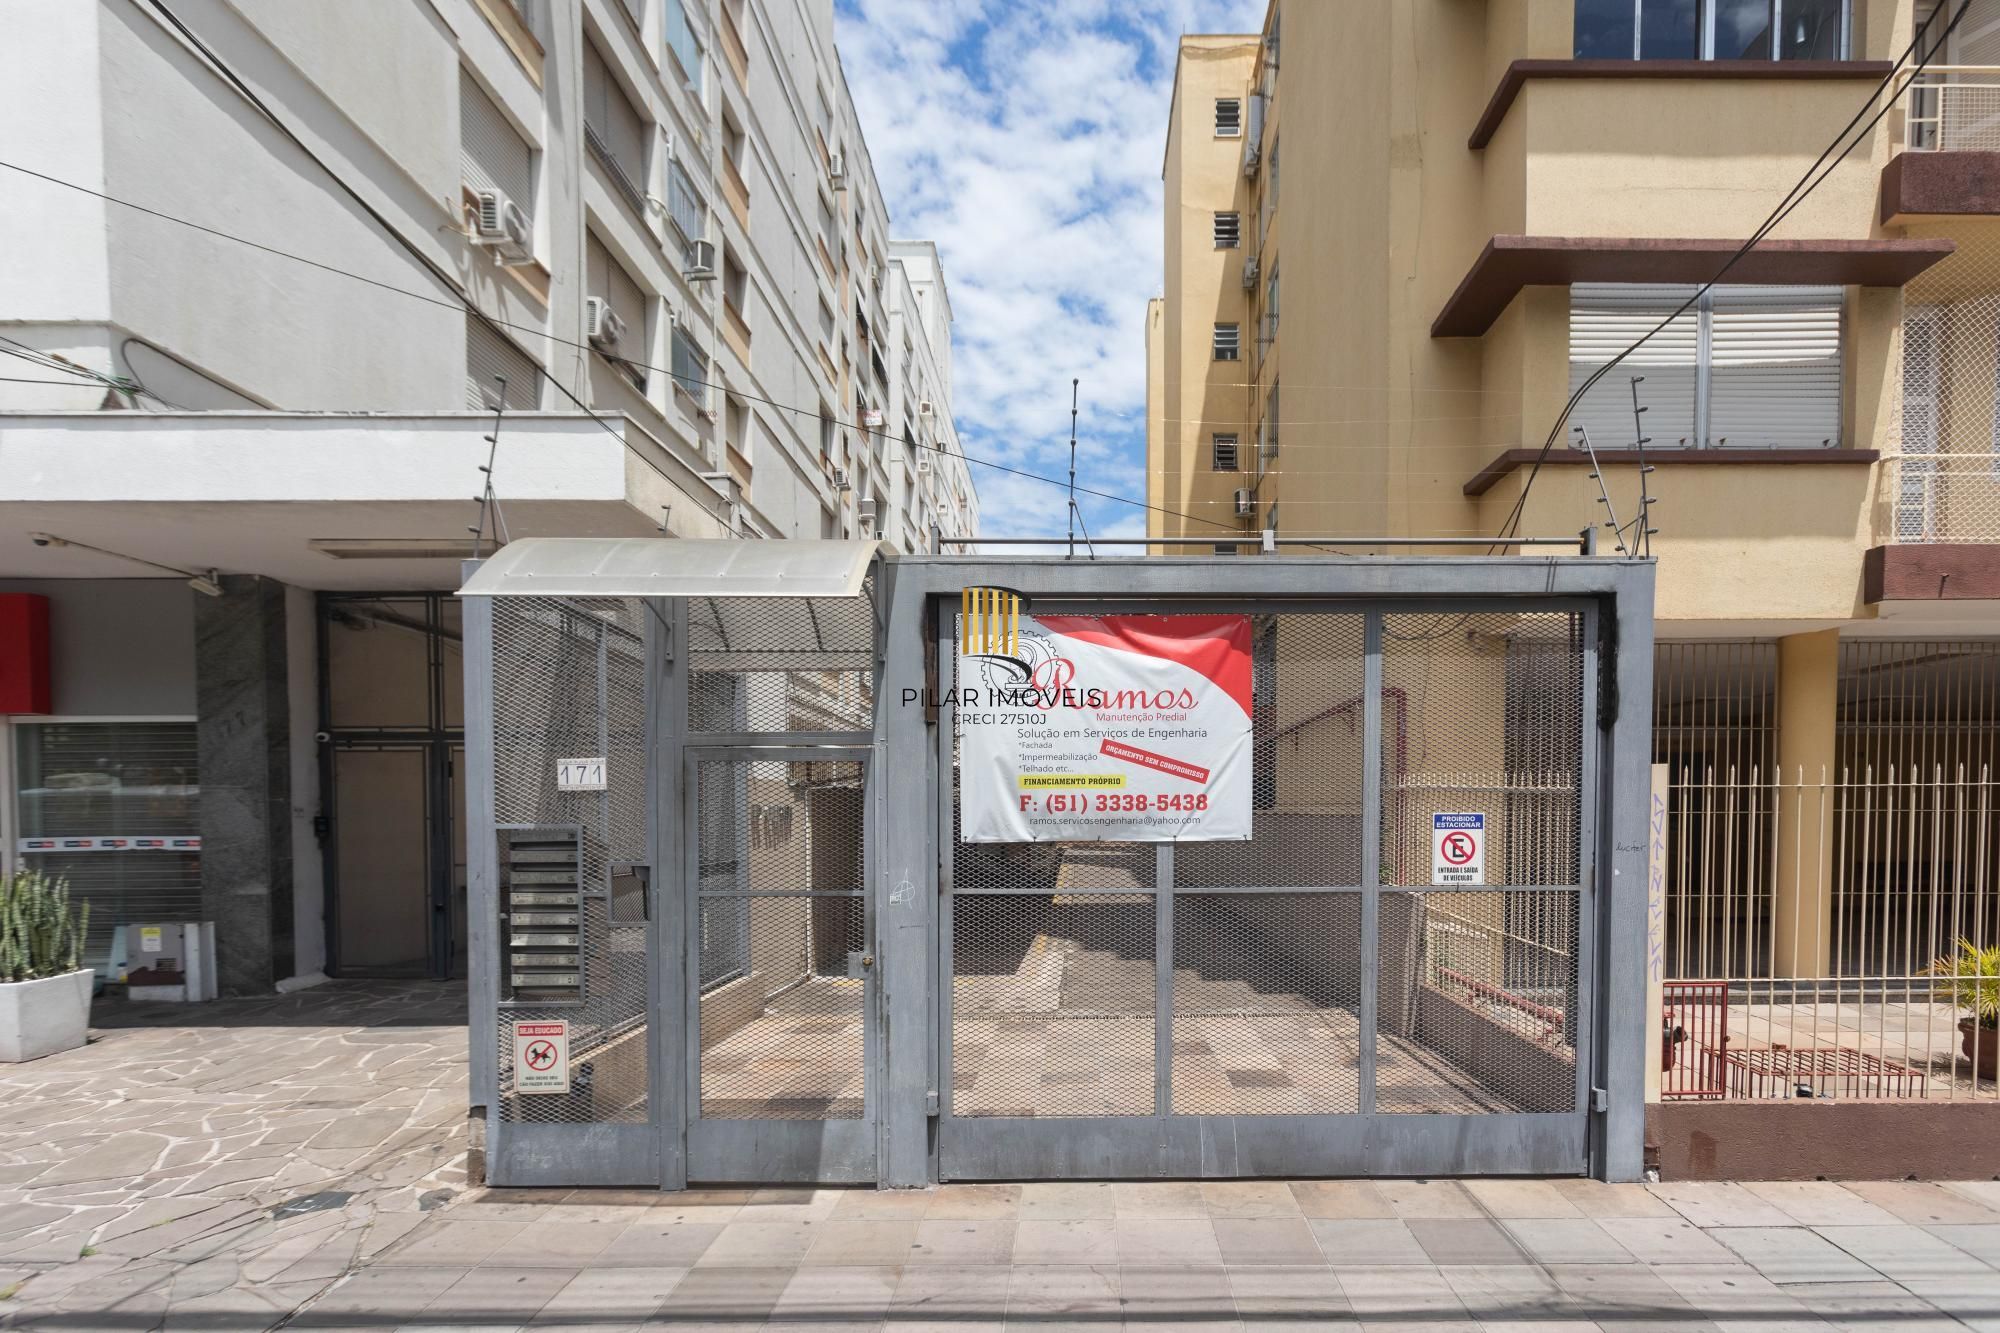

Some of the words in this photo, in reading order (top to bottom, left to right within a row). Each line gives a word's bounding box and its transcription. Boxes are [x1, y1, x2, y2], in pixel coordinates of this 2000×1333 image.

[1031, 658, 1199, 710] Ramos
[1096, 712, 1154, 723] Manutenção
[1156, 712, 1187, 721] Predial
[1017, 728, 1060, 740] Solução
[1083, 728, 1128, 740] Serviços
[1131, 728, 1145, 738] de
[1148, 728, 1208, 740] Engenharia
[1105, 745, 1144, 761] ORÇAMENTO
[1144, 756, 1160, 766] SEM
[1159, 761, 1204, 779] COMPROMISSO
[560, 765, 601, 784] 171
[1088, 777, 1121, 785] PRÓPRIO
[1019, 795, 1038, 812] F:
[1046, 794, 1088, 815] (51)
[1095, 794, 1208, 812] 3338-5438
